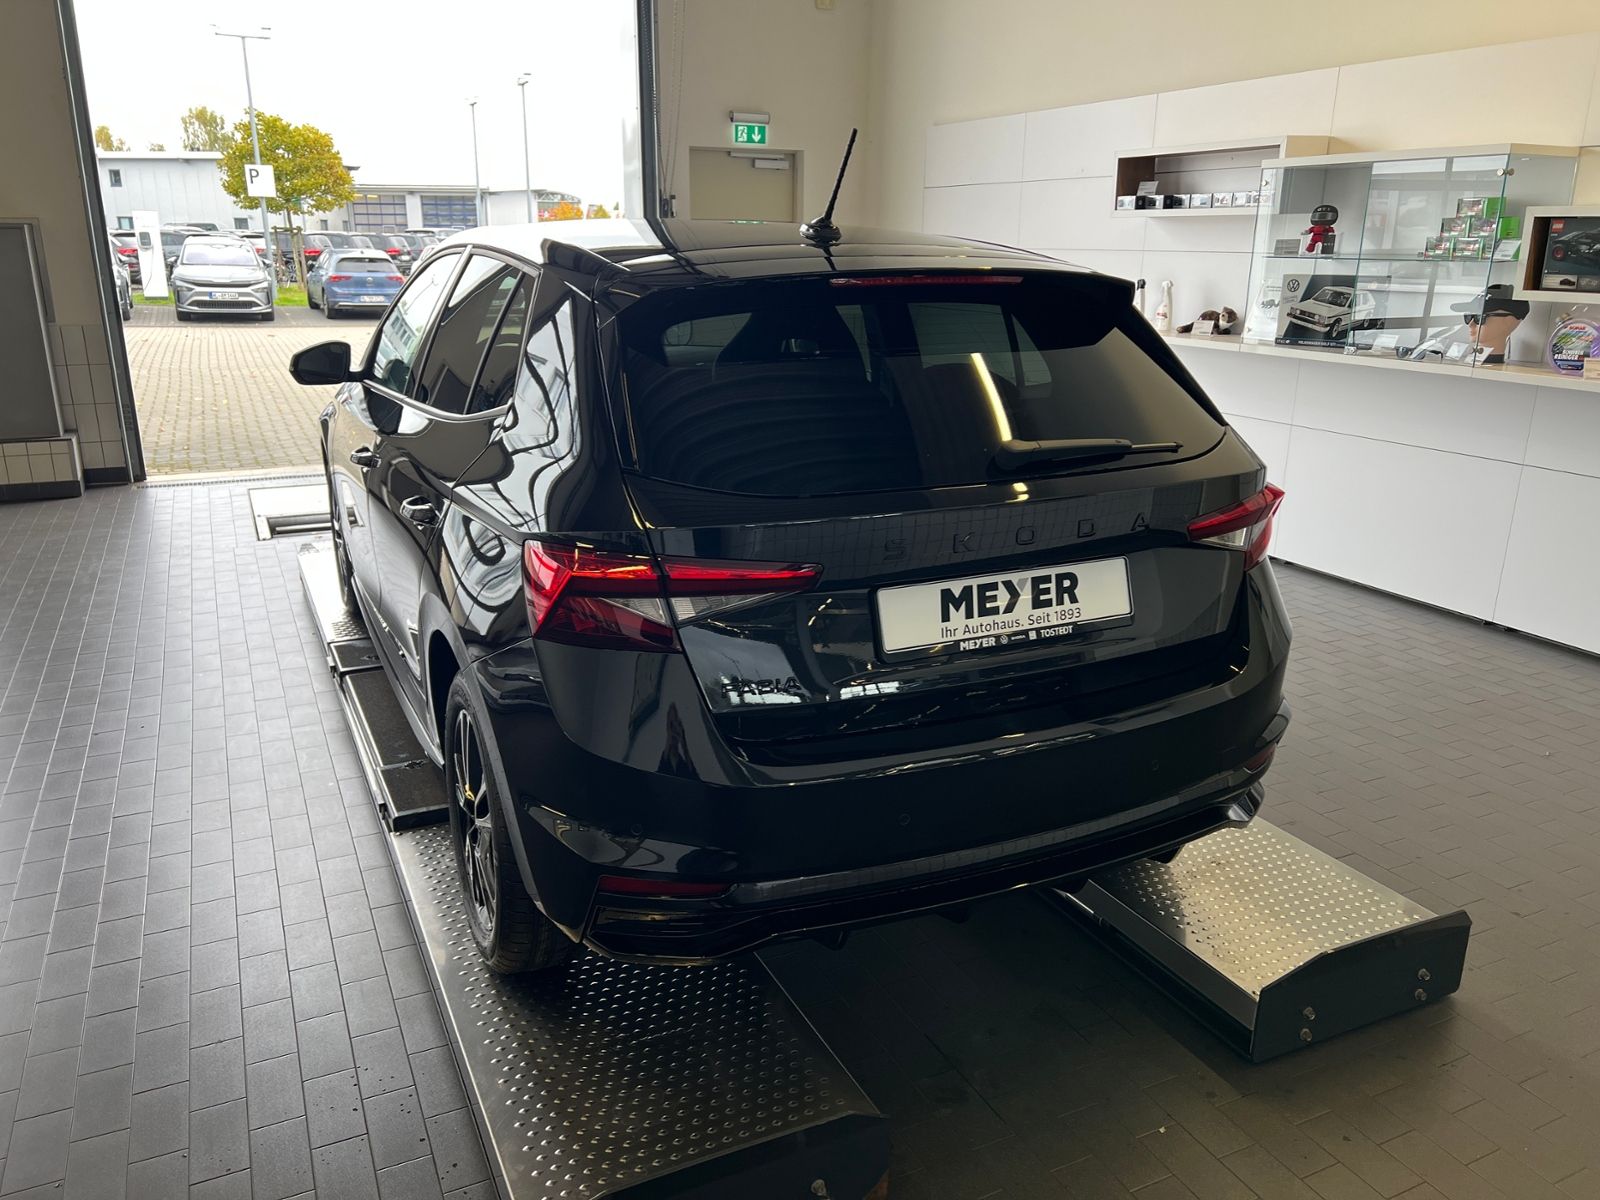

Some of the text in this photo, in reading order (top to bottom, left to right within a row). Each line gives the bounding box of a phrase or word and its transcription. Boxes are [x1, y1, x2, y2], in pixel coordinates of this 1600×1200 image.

[249, 168, 259, 184] P
[940, 571, 1080, 623] MEYER
[941, 607, 1082, 639] Ihr Autohaus. Seit 1893
[960, 637, 996, 651] MEYER
[1040, 625, 1074, 638] TOSTEDT
